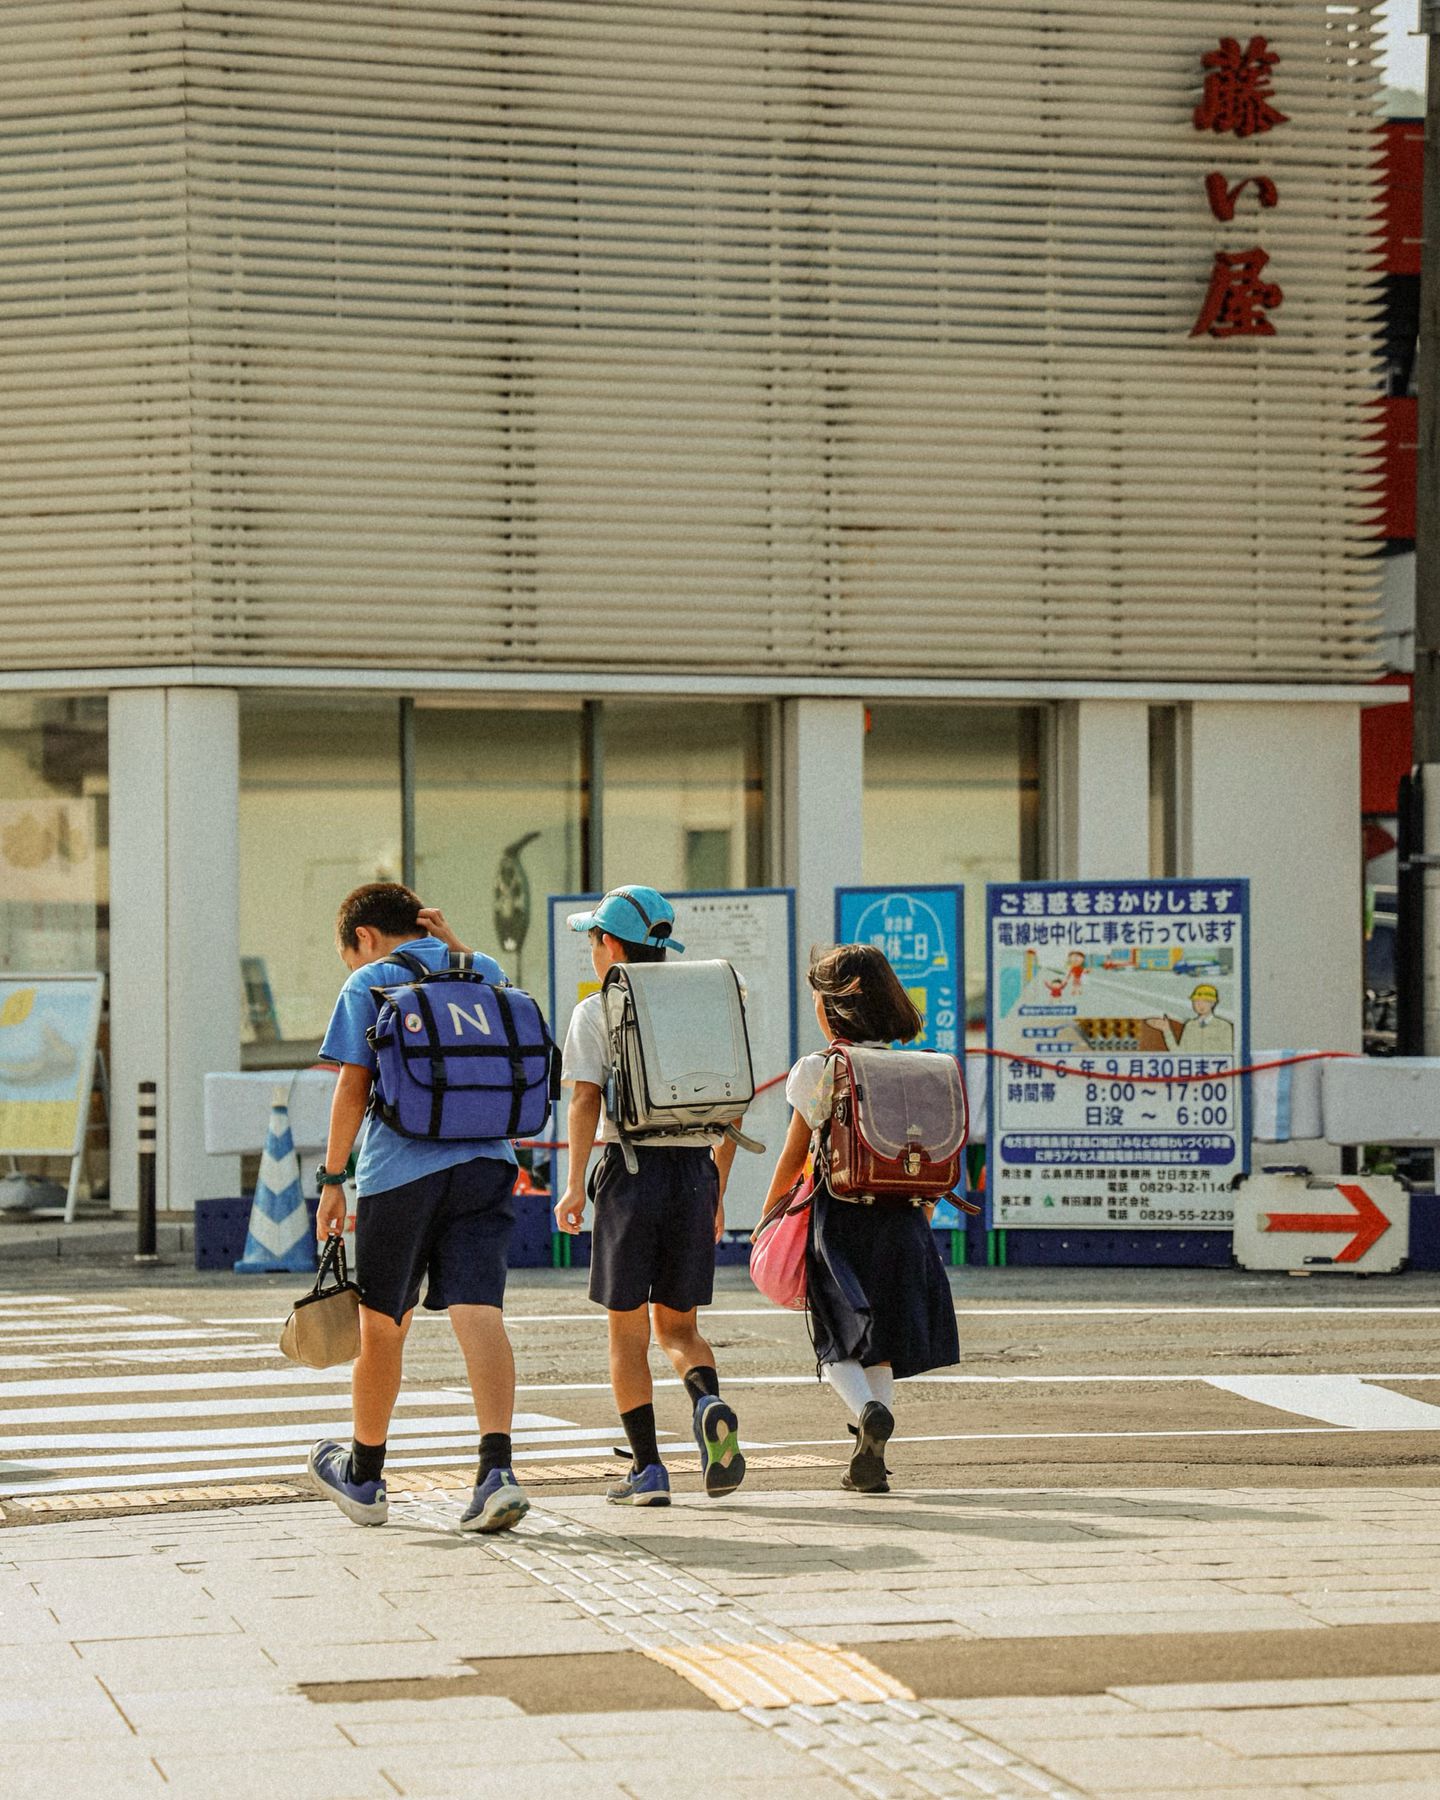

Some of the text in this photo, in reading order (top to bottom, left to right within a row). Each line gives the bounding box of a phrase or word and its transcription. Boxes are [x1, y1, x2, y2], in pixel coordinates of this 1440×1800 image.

[1189, 35, 1290, 339] 藤い屋
[1000, 889, 1234, 915] ご迷惑をおかけします
[999, 919, 1236, 946] 電線地中化工事を行っています
[447, 1003, 491, 1035] N
[1009, 1059, 1042, 1079] 令和
[1008, 1083, 1055, 1102] 時間帯
[1086, 1107, 1124, 1126] 日没
[1177, 1106, 1227, 1125] 6:00
[1157, 1169, 1210, 1179] 廿日市支所
[1107, 1183, 1128, 1193] 電話
[1107, 1210, 1234, 1220] 電話 0829-55-2239
